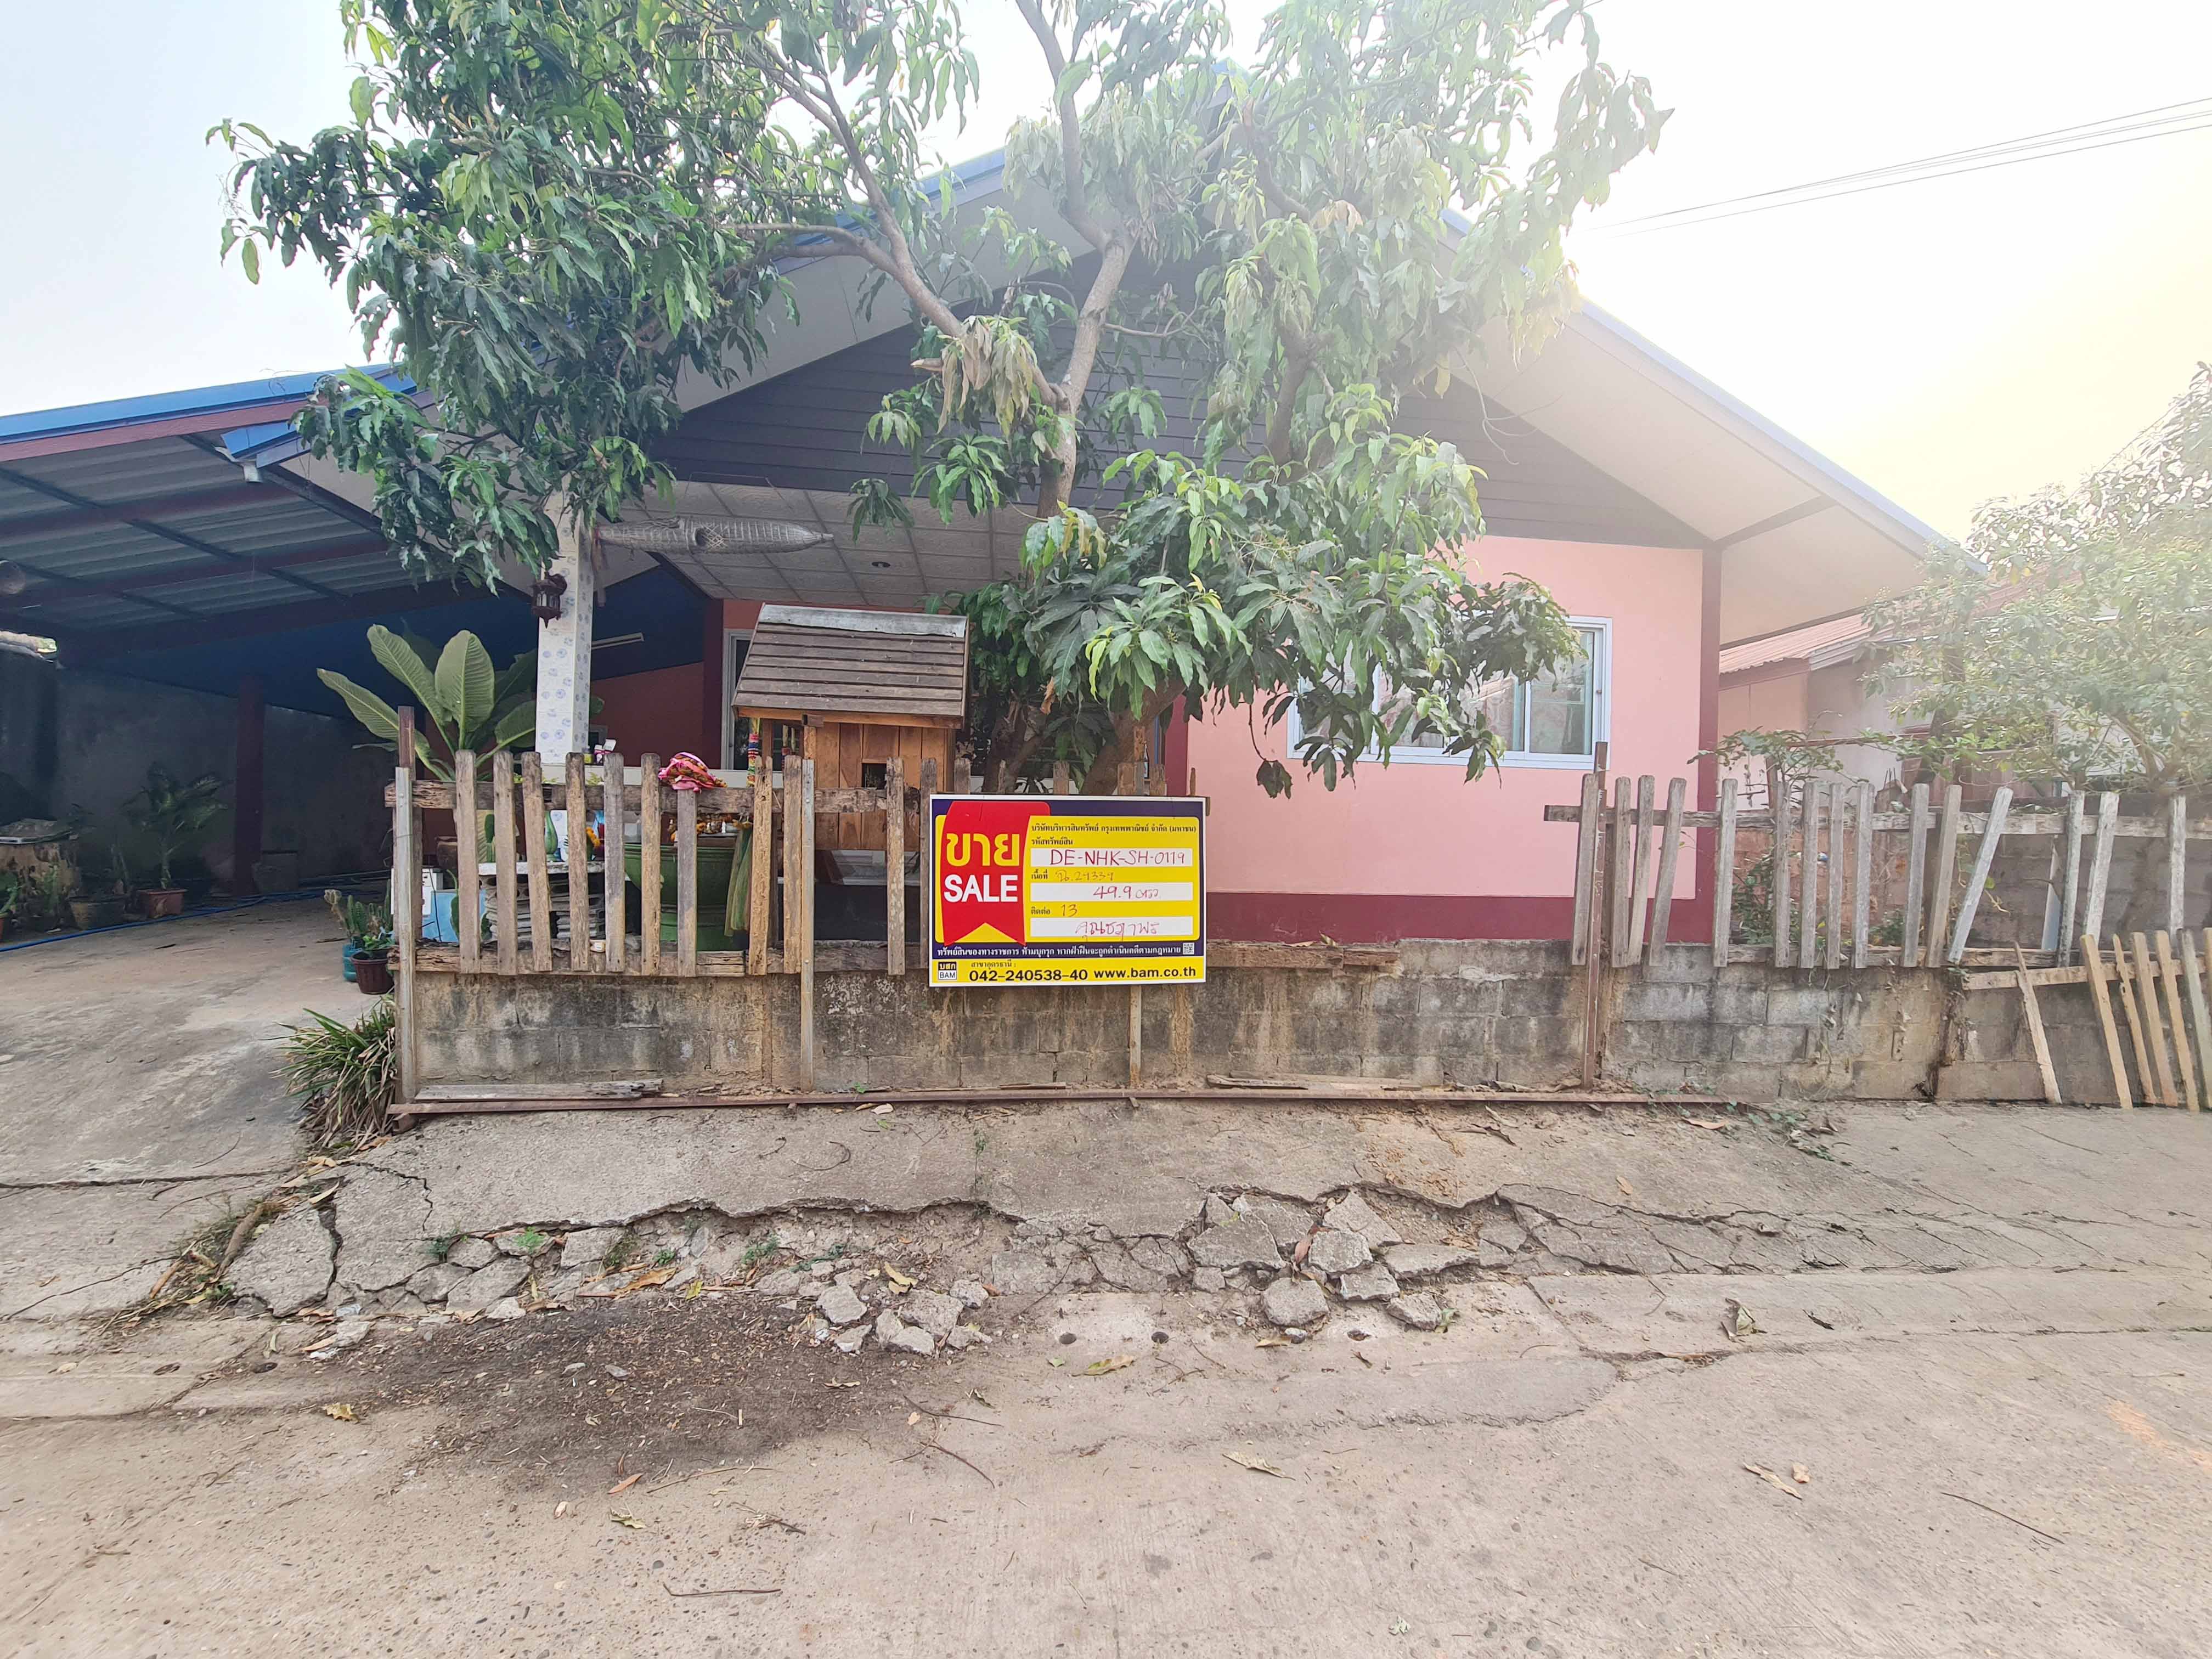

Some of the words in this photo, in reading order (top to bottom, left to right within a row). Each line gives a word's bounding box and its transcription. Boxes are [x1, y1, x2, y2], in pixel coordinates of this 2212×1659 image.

[1031, 822, 1099, 832] บริษัทบริหารสินทรัพย์
[1101, 823, 1149, 834] กรุงเทพพาณิชย์
[1151, 823, 1167, 832] จำกัด
[1031, 836, 1073, 845] รหัสทรัพย์สิน
[946, 833, 1019, 866] ขาย
[1031, 870, 1048, 880] เนื้อที่
[944, 874, 1018, 902] SALE
[1092, 886, 1131, 899] 49.9
[1031, 907, 1051, 915] ติดต่อ
[1060, 904, 1079, 917] 13
[937, 946, 1019, 956] ทรัพย์สินของทางราชการ
[1022, 946, 1054, 958] ห้ามบุกรุก
[971, 959, 1012, 969] สาขาอุดรธานี
[969, 969, 1088, 981] 042-240538-40
[1094, 967, 1196, 979] www.bam.co.th
